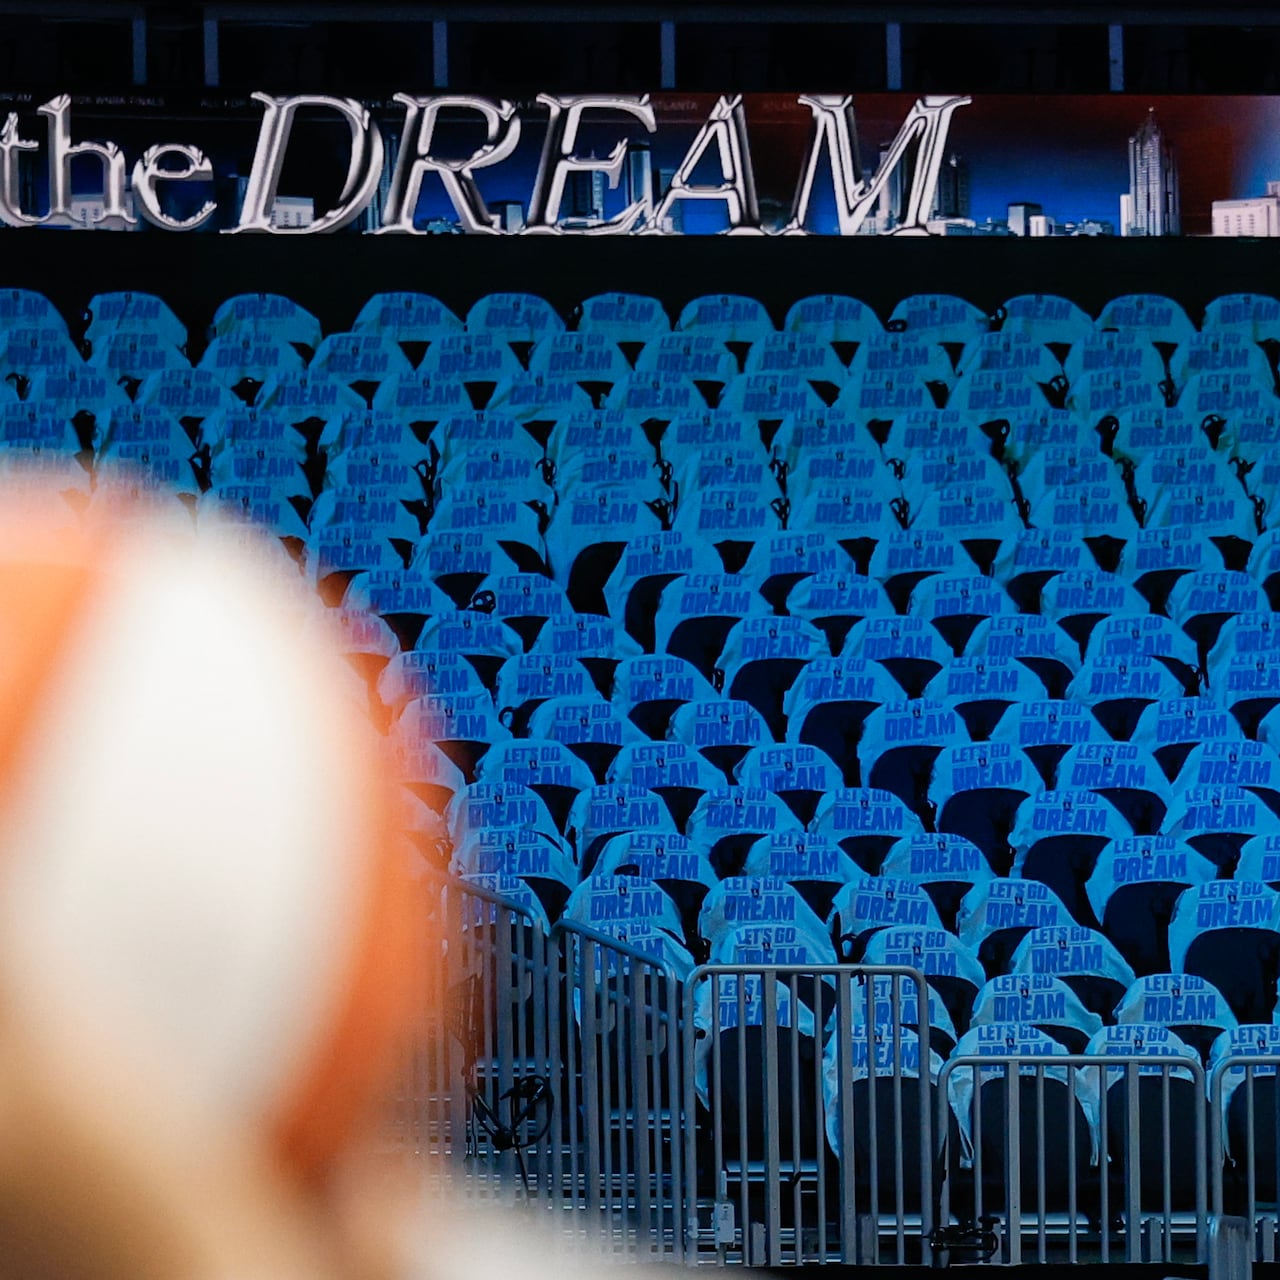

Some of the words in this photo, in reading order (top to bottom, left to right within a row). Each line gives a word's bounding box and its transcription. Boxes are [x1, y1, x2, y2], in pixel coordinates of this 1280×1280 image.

[220, 91, 972, 236] DREAM
[1136, 543, 1202, 570] DREAM
[539, 746, 561, 762] GO
[667, 743, 686, 760] GO
[1113, 744, 1137, 760] GO
[504, 766, 571, 786] DREAM
[631, 764, 699, 787] DREAM
[1072, 764, 1146, 787] DREAM
[1199, 761, 1270, 783] DREAM
[667, 834, 689, 849] GO
[629, 854, 698, 879] DREAM
[724, 896, 795, 921] DREAM
[1066, 926, 1090, 942] GO
[1031, 946, 1102, 973] DREAM
